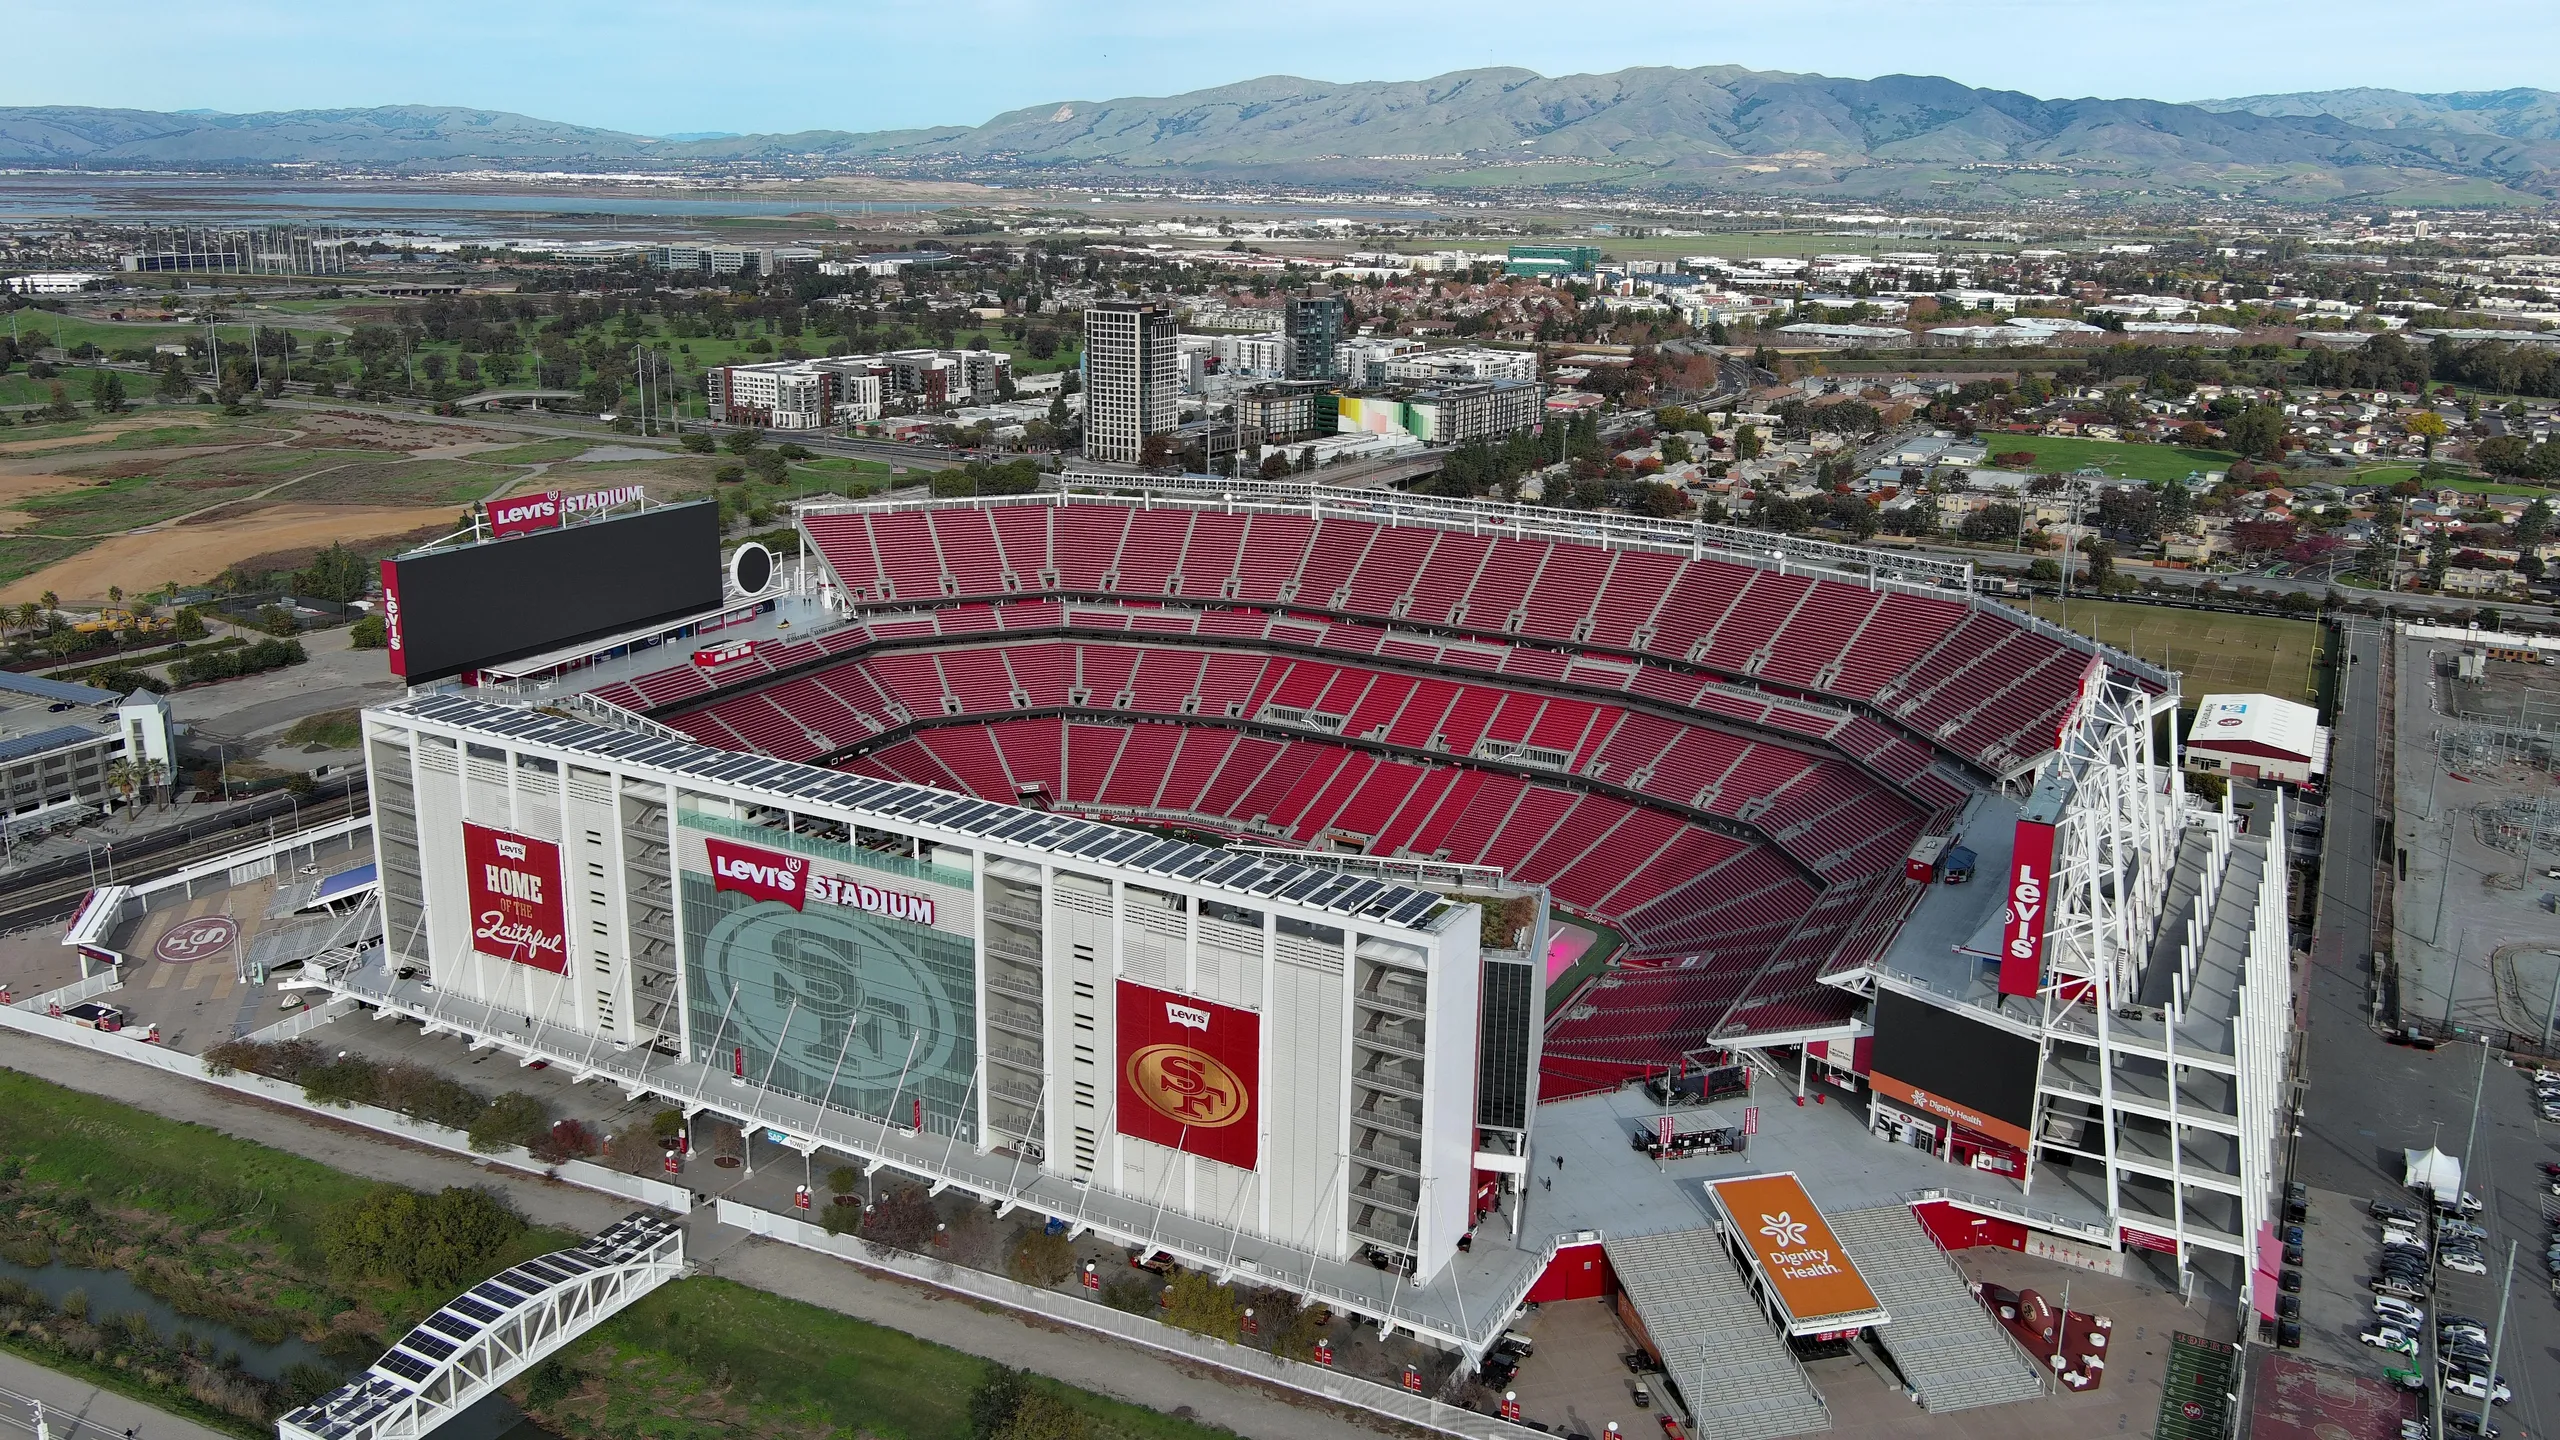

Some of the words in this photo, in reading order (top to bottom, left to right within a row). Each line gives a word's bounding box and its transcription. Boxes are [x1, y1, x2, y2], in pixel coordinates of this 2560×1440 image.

[497, 501, 556, 525] Levi's
[566, 486, 642, 513] STADIUM
[386, 588, 402, 652] Levi's
[500, 843, 524, 856] Levi's
[485, 863, 543, 905] HOME
[716, 855, 796, 892] Levi's
[812, 875, 935, 926] STADIUM
[500, 897, 512, 913] OF
[514, 901, 533, 919] THE
[2010, 864, 2041, 960] Levi's
[476, 910, 564, 960] Faithful
[1171, 1008, 1205, 1025] Levi's
[1929, 1099, 1957, 1118] Dignity
[1956, 1111, 1983, 1127] Health
[767, 1132, 783, 1143] SAP
[1769, 1247, 1830, 1266] Dignity
[1781, 1263, 1839, 1280] Health
